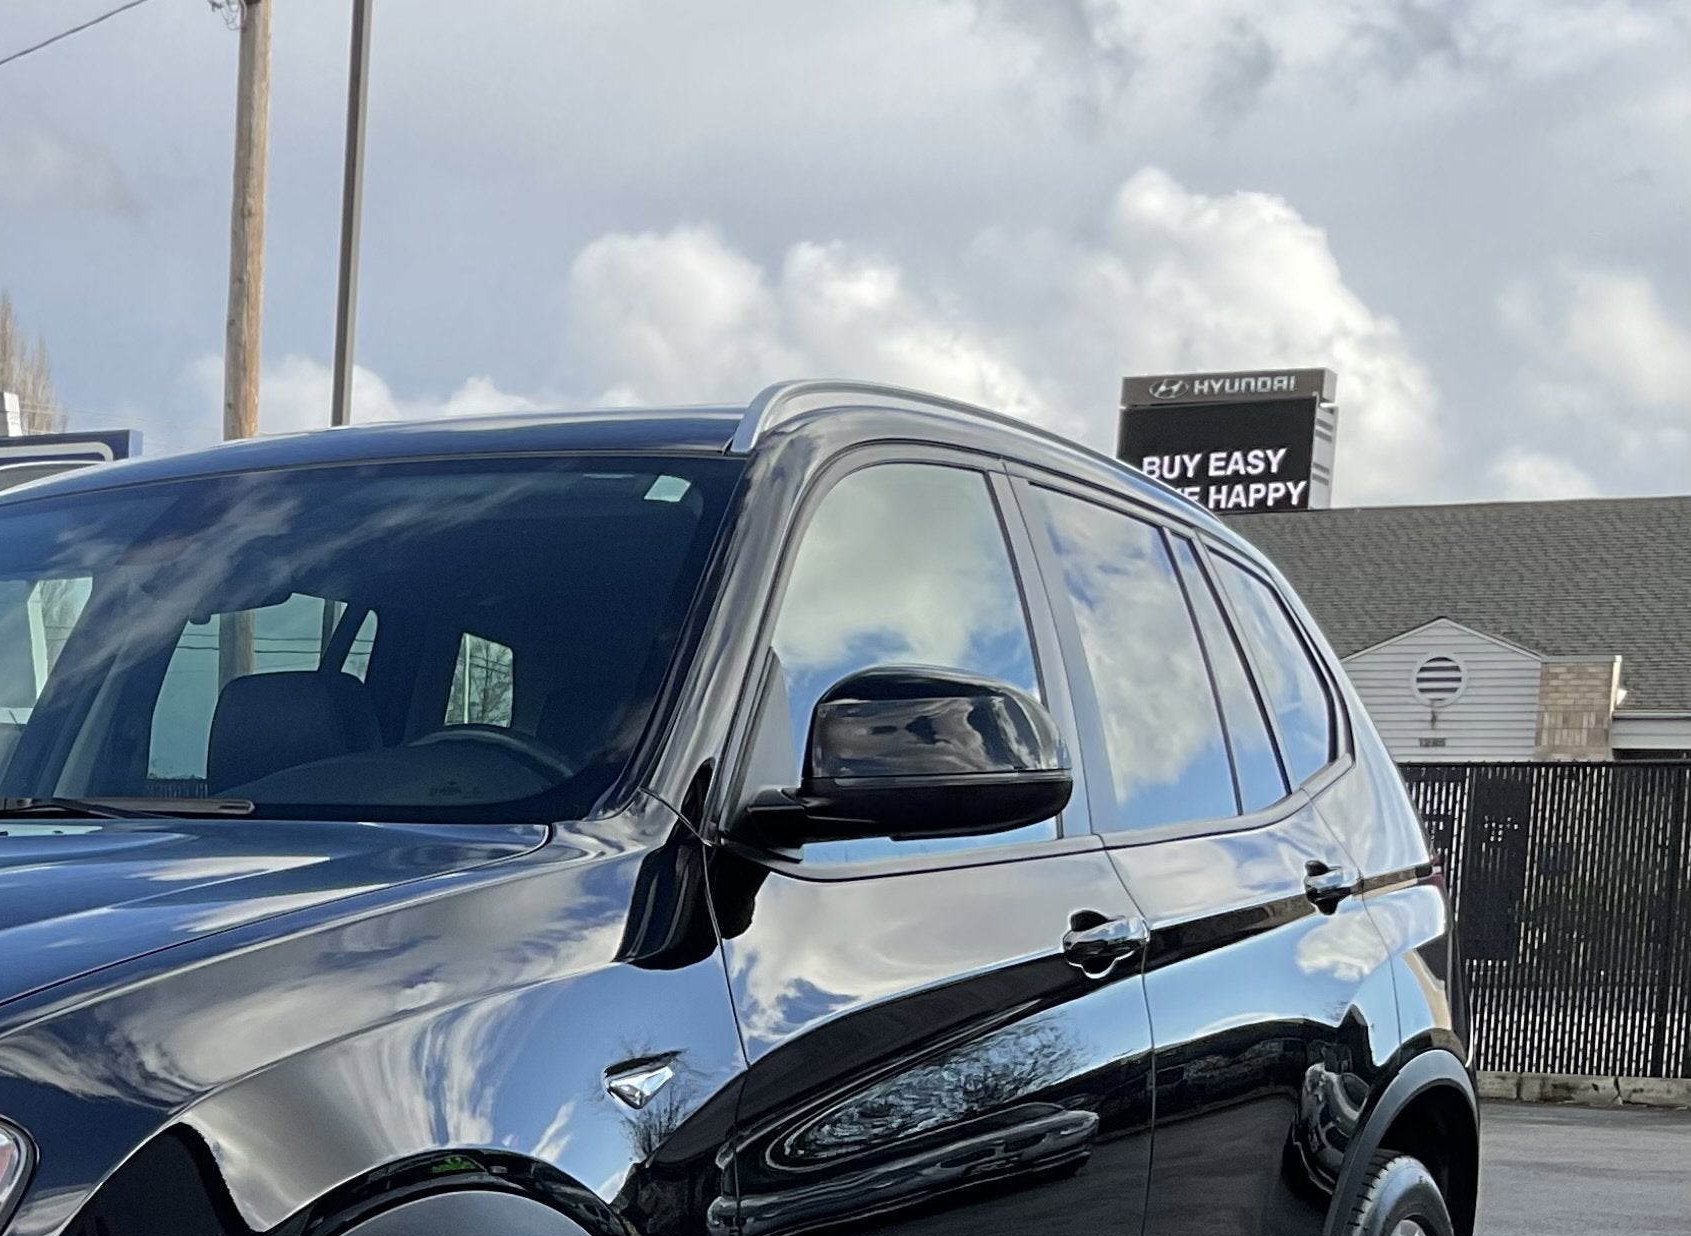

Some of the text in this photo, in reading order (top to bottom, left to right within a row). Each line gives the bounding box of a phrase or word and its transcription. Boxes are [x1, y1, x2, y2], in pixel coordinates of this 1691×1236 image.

[1194, 375, 1296, 395] HYUNDAI
[1142, 448, 1287, 480] BUY EASY
[1208, 480, 1307, 509] HAPPY
